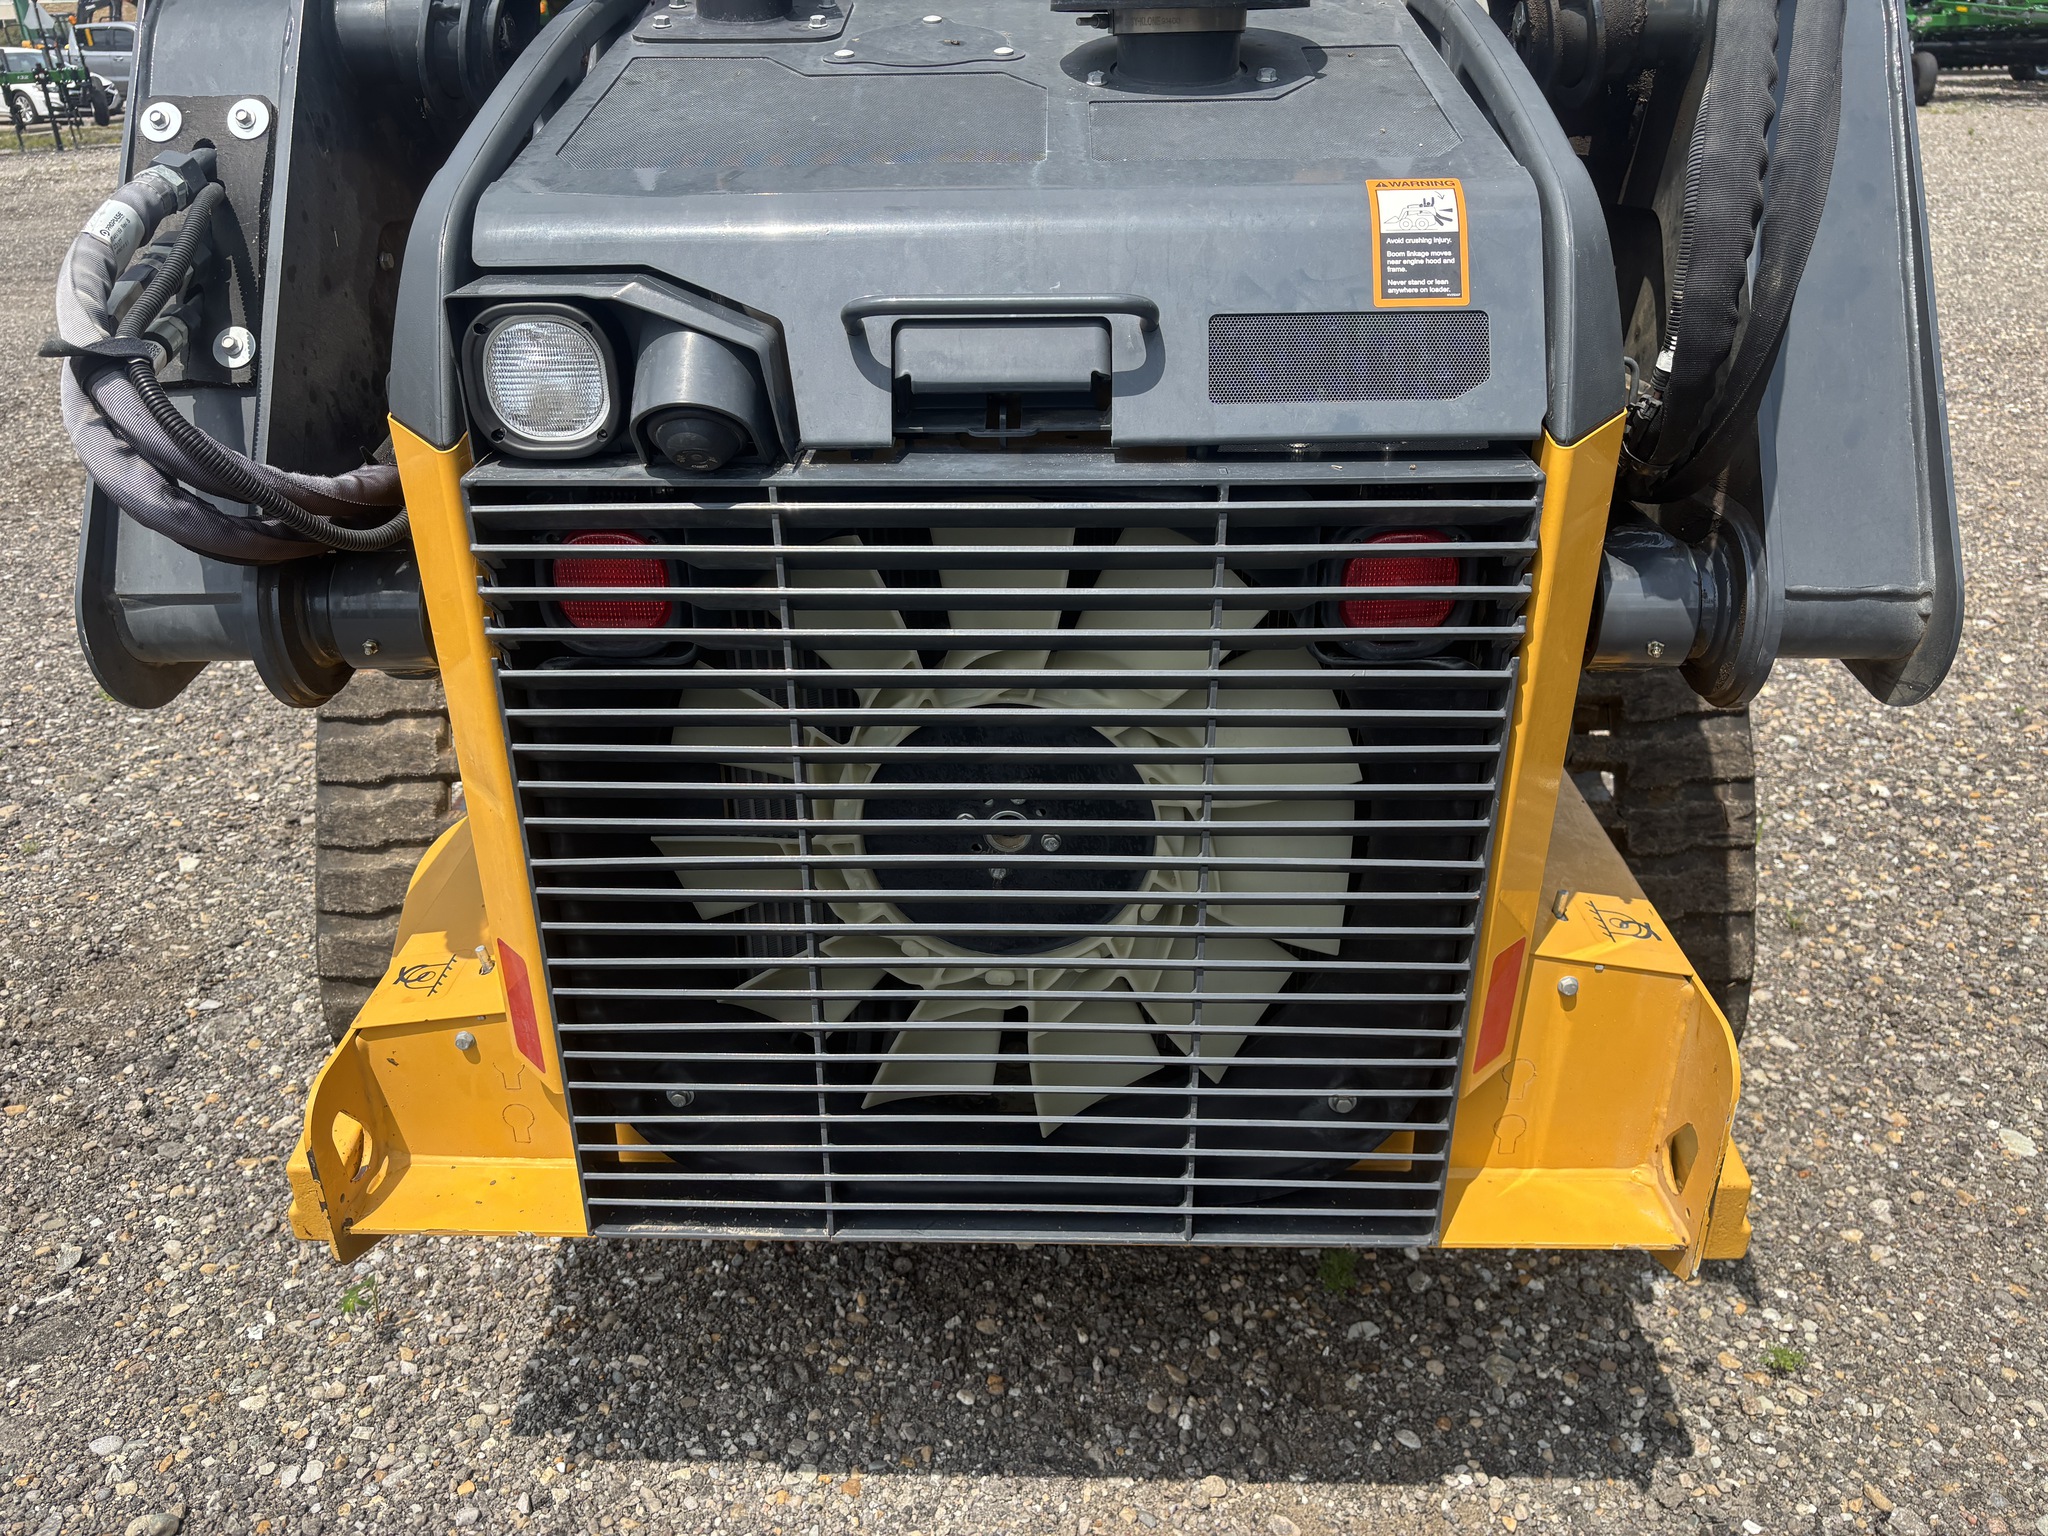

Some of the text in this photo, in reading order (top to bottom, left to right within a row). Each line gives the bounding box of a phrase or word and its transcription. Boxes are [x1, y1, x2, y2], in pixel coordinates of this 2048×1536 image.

[1388, 180, 1455, 188] WARNING
[1405, 237, 1432, 245] crushing
[1433, 236, 1452, 245] injury.
[1406, 250, 1429, 258] linkage
[1402, 258, 1424, 266] engine
